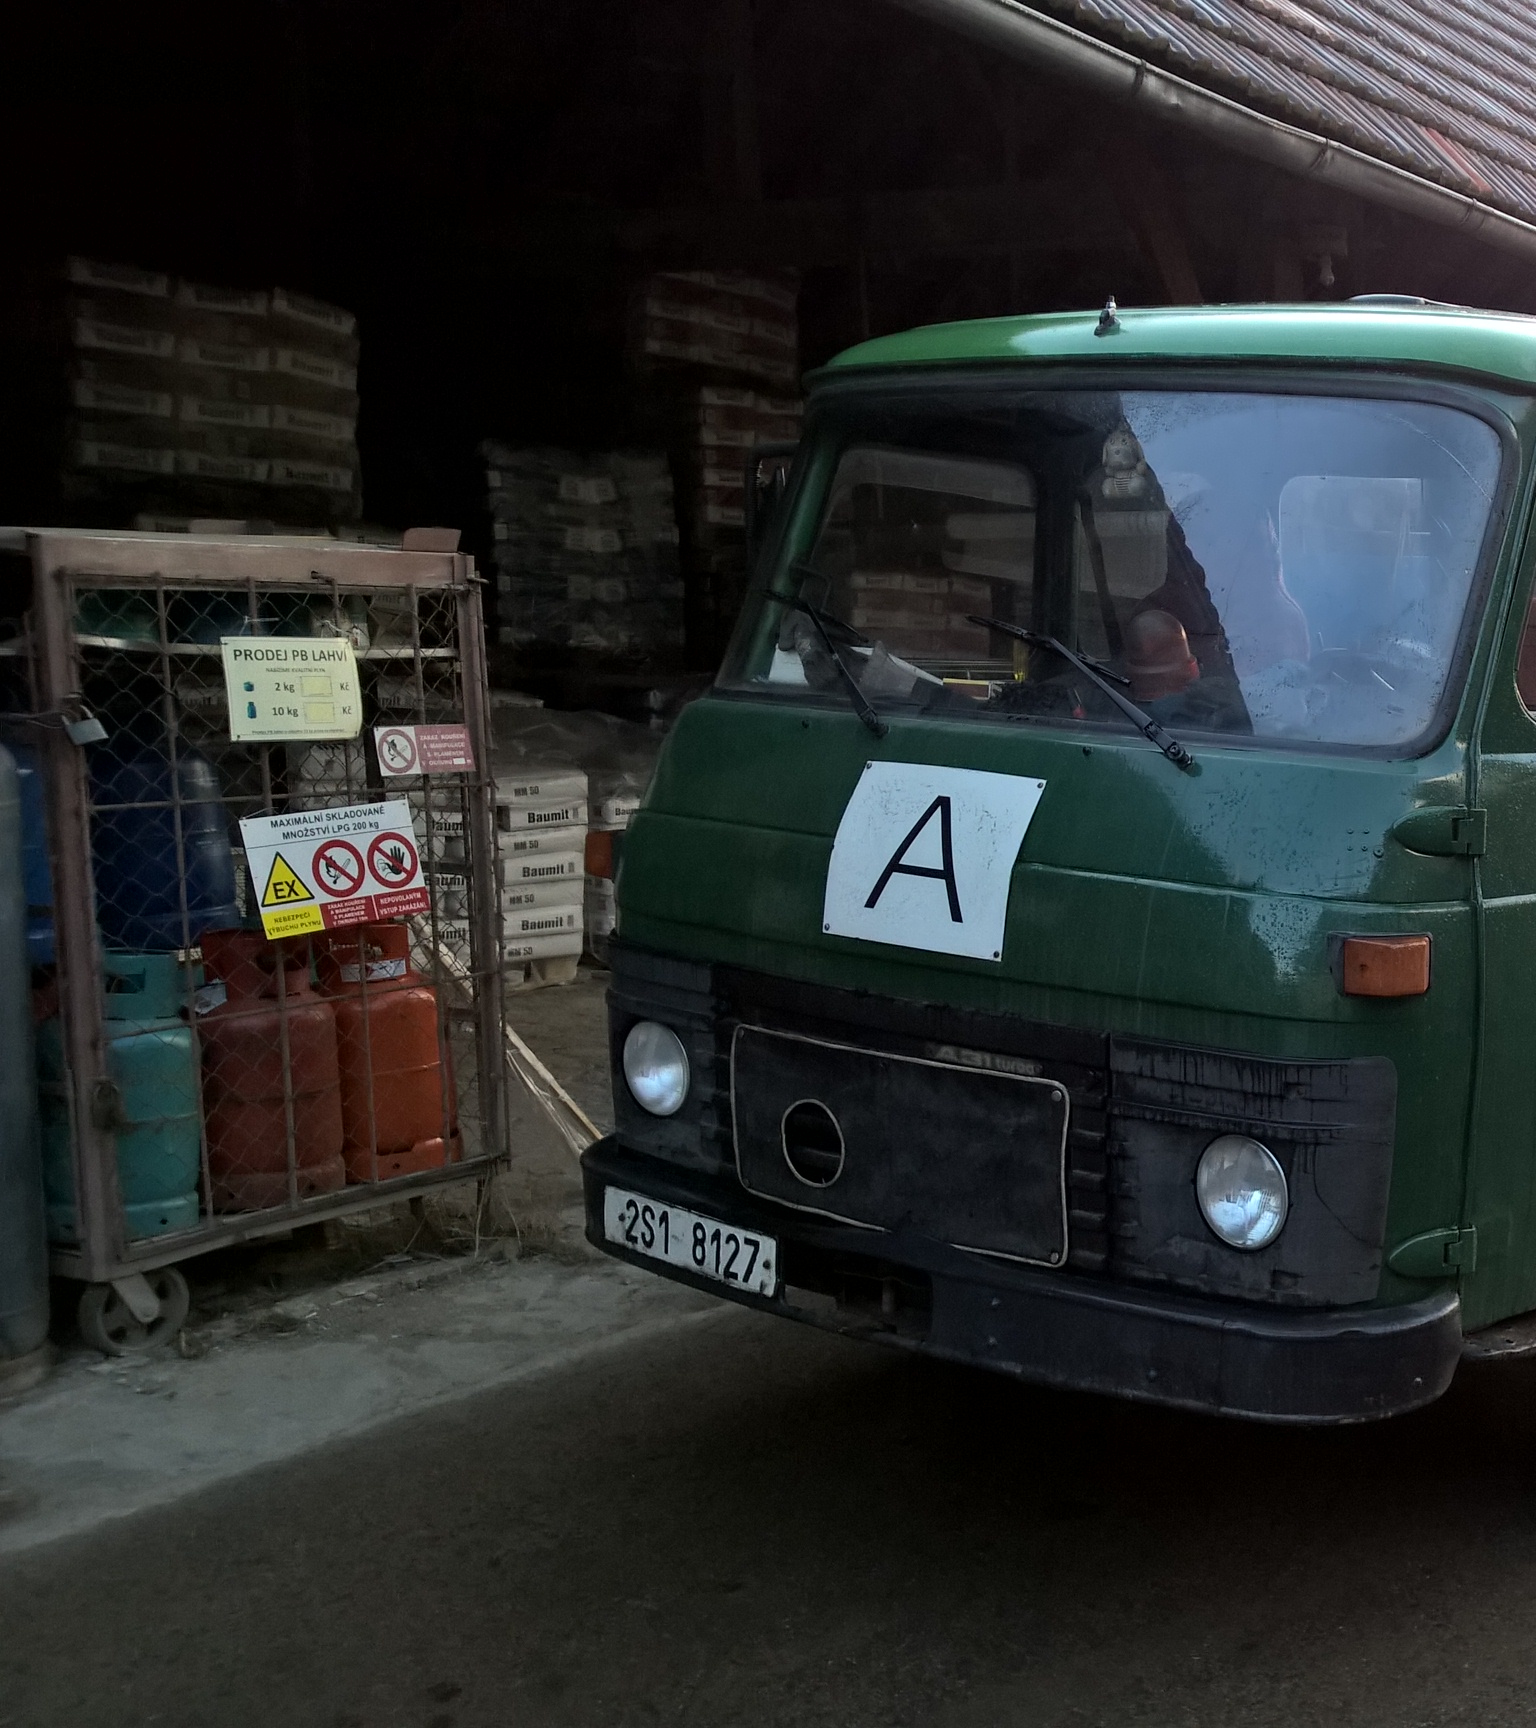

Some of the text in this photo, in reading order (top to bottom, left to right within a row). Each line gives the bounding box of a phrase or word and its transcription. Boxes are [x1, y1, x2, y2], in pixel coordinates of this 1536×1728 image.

[233, 649, 288, 662] PRODEJ
[292, 649, 309, 662] PB
[274, 682, 350, 693] 2 kg Kč
[272, 706, 352, 717] 10 kg Kč
[529, 785, 540, 796] 50
[326, 805, 385, 822] SKLADOVANÉ
[527, 809, 569, 824] Baumit
[282, 820, 379, 840] MNOŽSTVÍ LPG 200 kg
[528, 840, 539, 849] 50
[864, 795, 964, 923] A
[522, 864, 564, 878] Baumit
[272, 879, 299, 899] EX
[524, 893, 534, 904] 50
[379, 906, 398, 916] VSTUP
[300, 919, 321, 928] PLYNU
[521, 917, 563, 931] Baumit
[523, 946, 533, 956] 50
[625, 1199, 760, 1283] 2S1 8127
